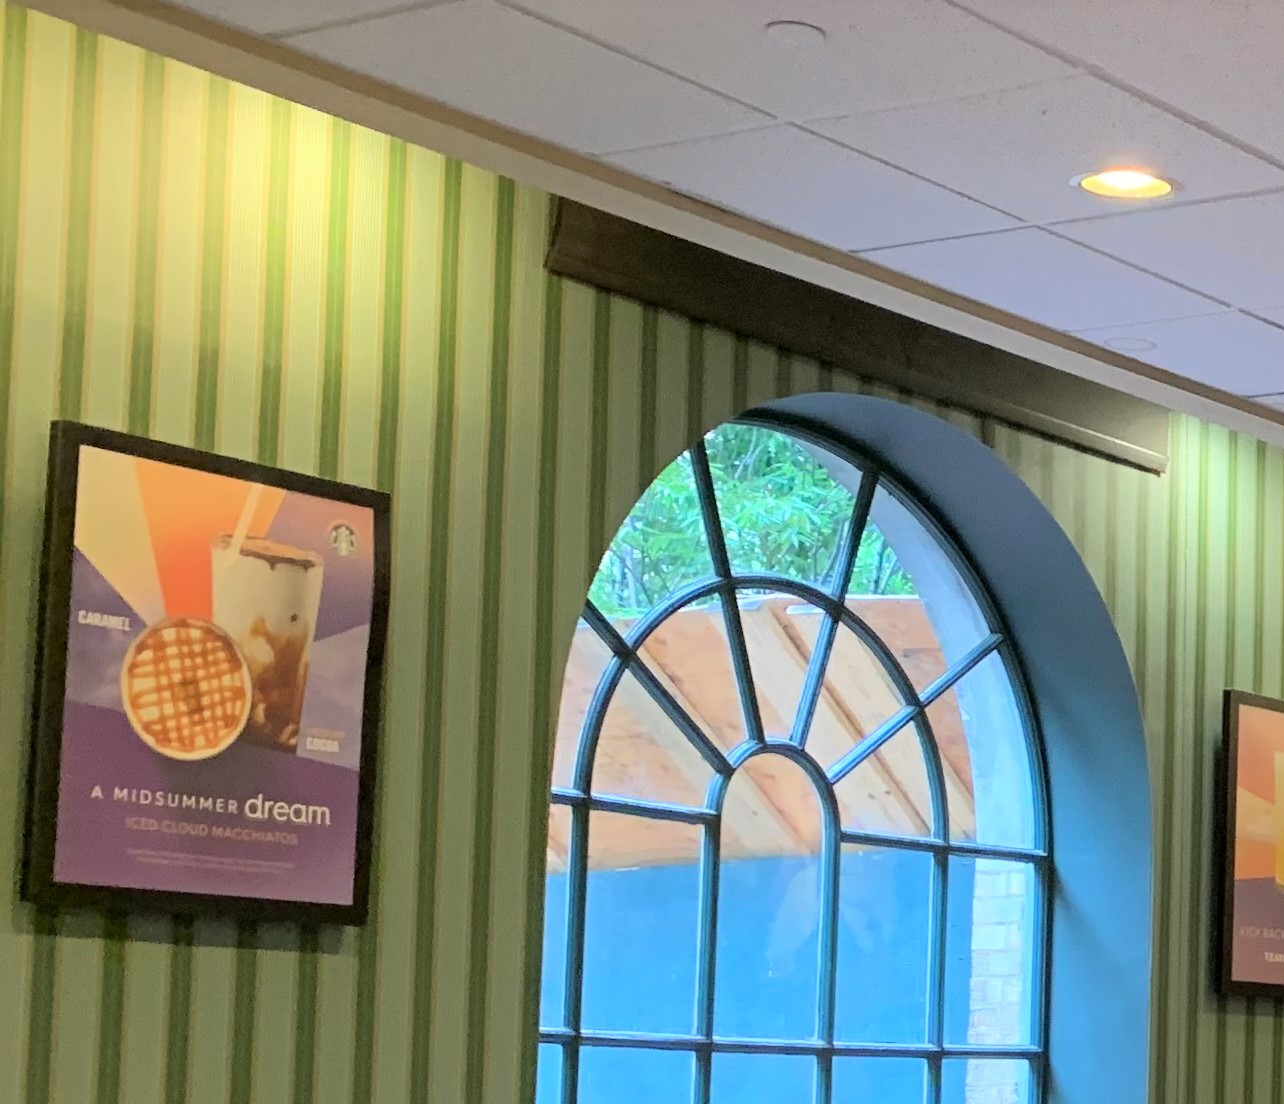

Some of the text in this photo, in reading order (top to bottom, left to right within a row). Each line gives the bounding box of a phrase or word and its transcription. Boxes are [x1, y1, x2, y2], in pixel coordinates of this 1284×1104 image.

[90, 785, 331, 827] A MIDSUMMER dream
[126, 817, 299, 845] ICED CLOUD MACCHIATOS
